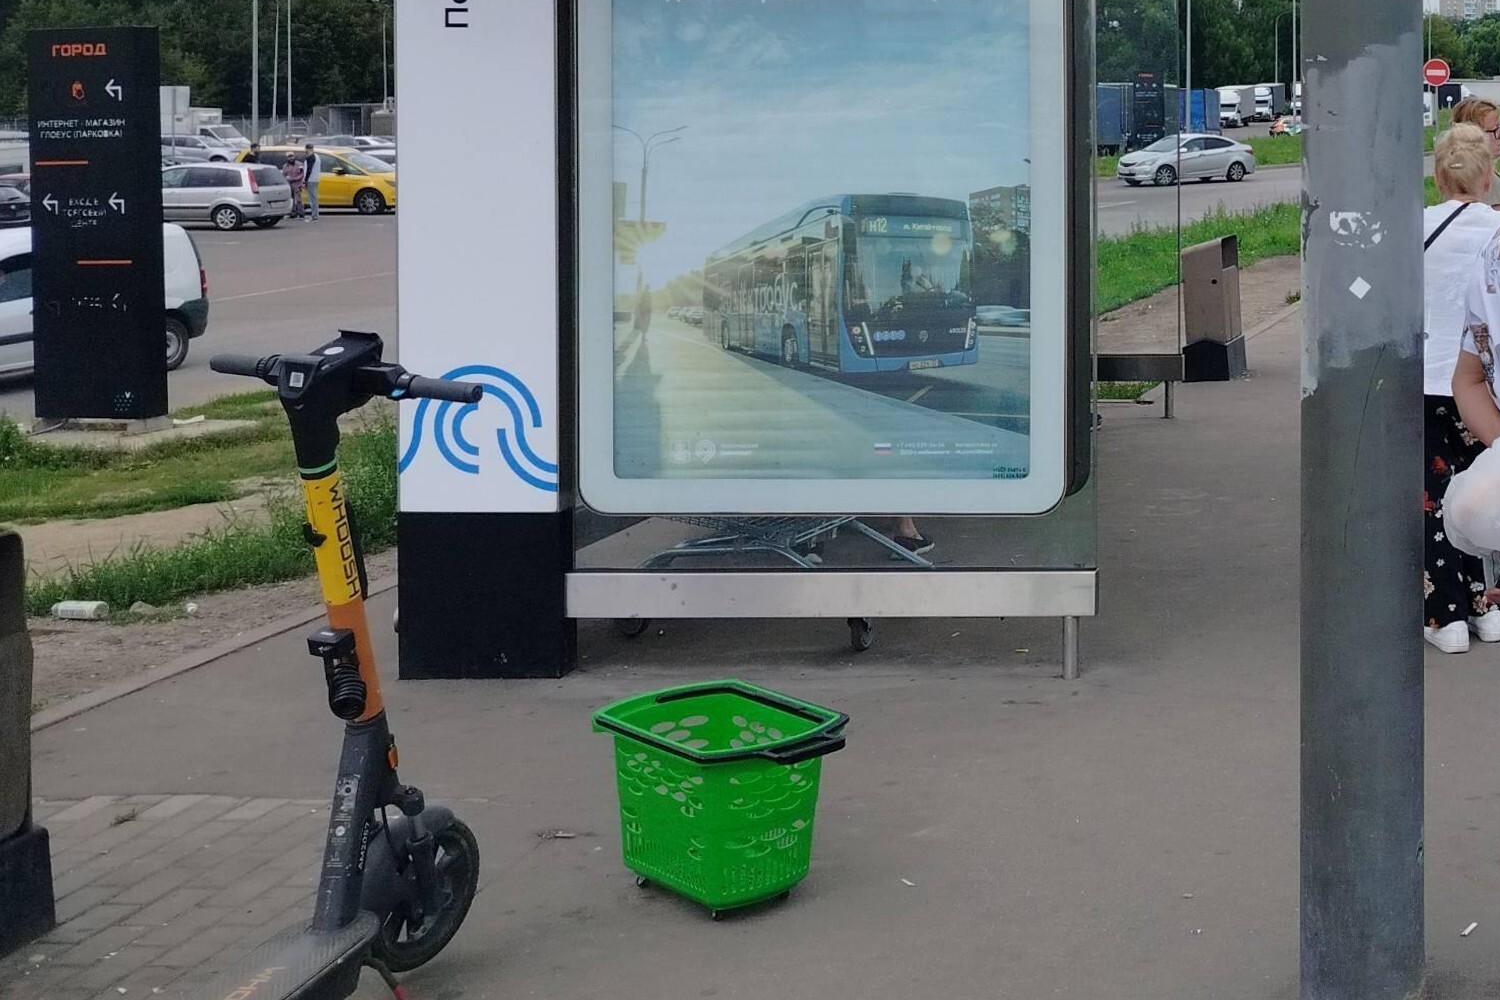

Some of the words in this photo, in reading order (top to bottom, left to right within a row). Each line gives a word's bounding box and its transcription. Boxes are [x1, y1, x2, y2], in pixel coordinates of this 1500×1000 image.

[51, 43, 107, 57] ГОРОД
[37, 120, 79, 129] ИНТЕРНЕТ
[84, 118, 125, 127] МАГАЗИН
[329, 480, 360, 599] WHOOSH
